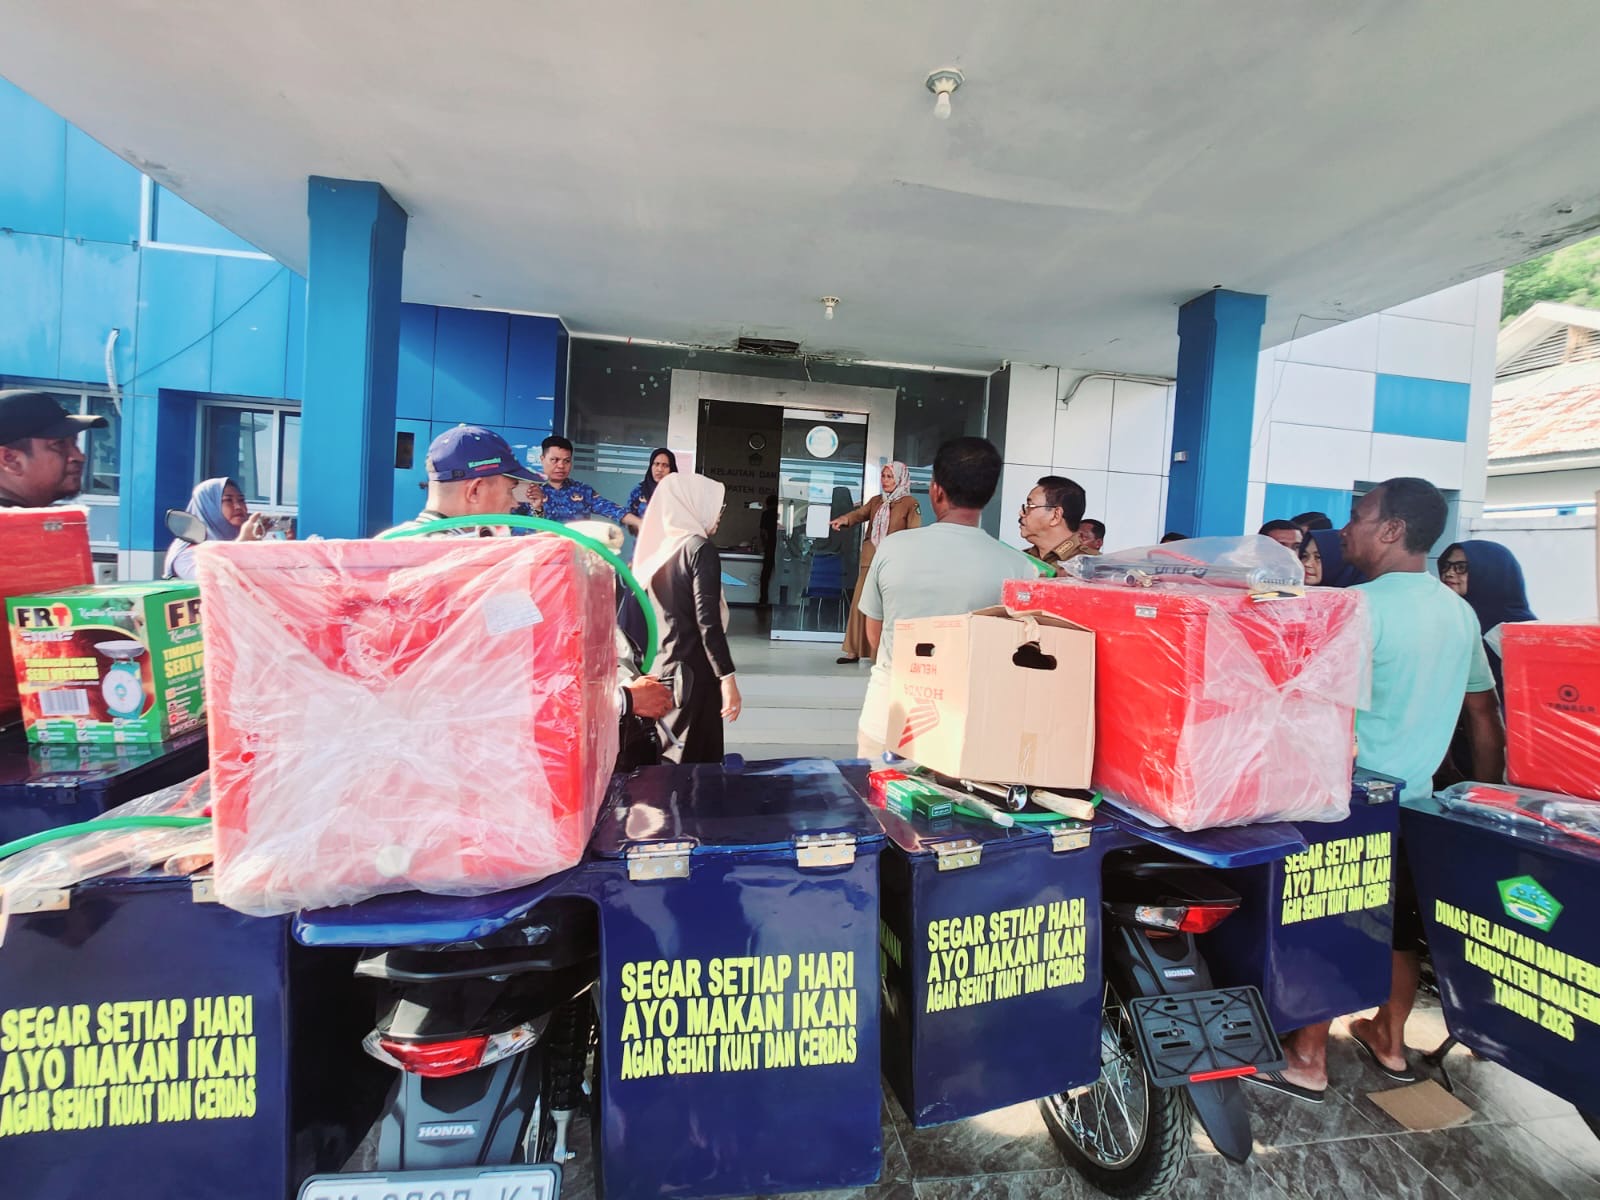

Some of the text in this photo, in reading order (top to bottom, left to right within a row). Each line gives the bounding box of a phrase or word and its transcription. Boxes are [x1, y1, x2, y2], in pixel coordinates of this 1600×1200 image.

[15, 607, 68, 628] FRT
[1283, 857, 1392, 900] AYO MAKAN IKAN
[1285, 831, 1391, 873] SEGAR SETIAP HARI
[927, 914, 985, 952] SEGAR
[989, 905, 1045, 942] SETIAP
[1048, 897, 1085, 931] HARI
[1435, 899, 1469, 934] DINAS
[1470, 913, 1535, 965] KELAUTAN
[1536, 942, 1566, 979] DAN
[621, 951, 854, 1002] SEGAR SETIAP HARI
[927, 948, 969, 983] AYO
[974, 934, 1039, 976] MAKAN
[1044, 926, 1086, 961] IKAN
[1464, 938, 1538, 996] KABUPATEN
[926, 954, 1085, 1014] AGAR SEHAT KUAT DAN CERDAS
[1493, 978, 1538, 1023] TAHUN
[1, 995, 253, 1052] SEGAR SETIAP HARI
[621, 989, 857, 1041] AYO MAKAN IKAN
[0, 1036, 257, 1095] AYO MAKAN IKAN
[621, 1026, 857, 1080] AGAR SEHAT KUAT DAN CERDAS
[0, 1077, 257, 1138] AGAR SEHAT KUAT DAN CERDAS
[417, 1124, 476, 1138] HONDA
